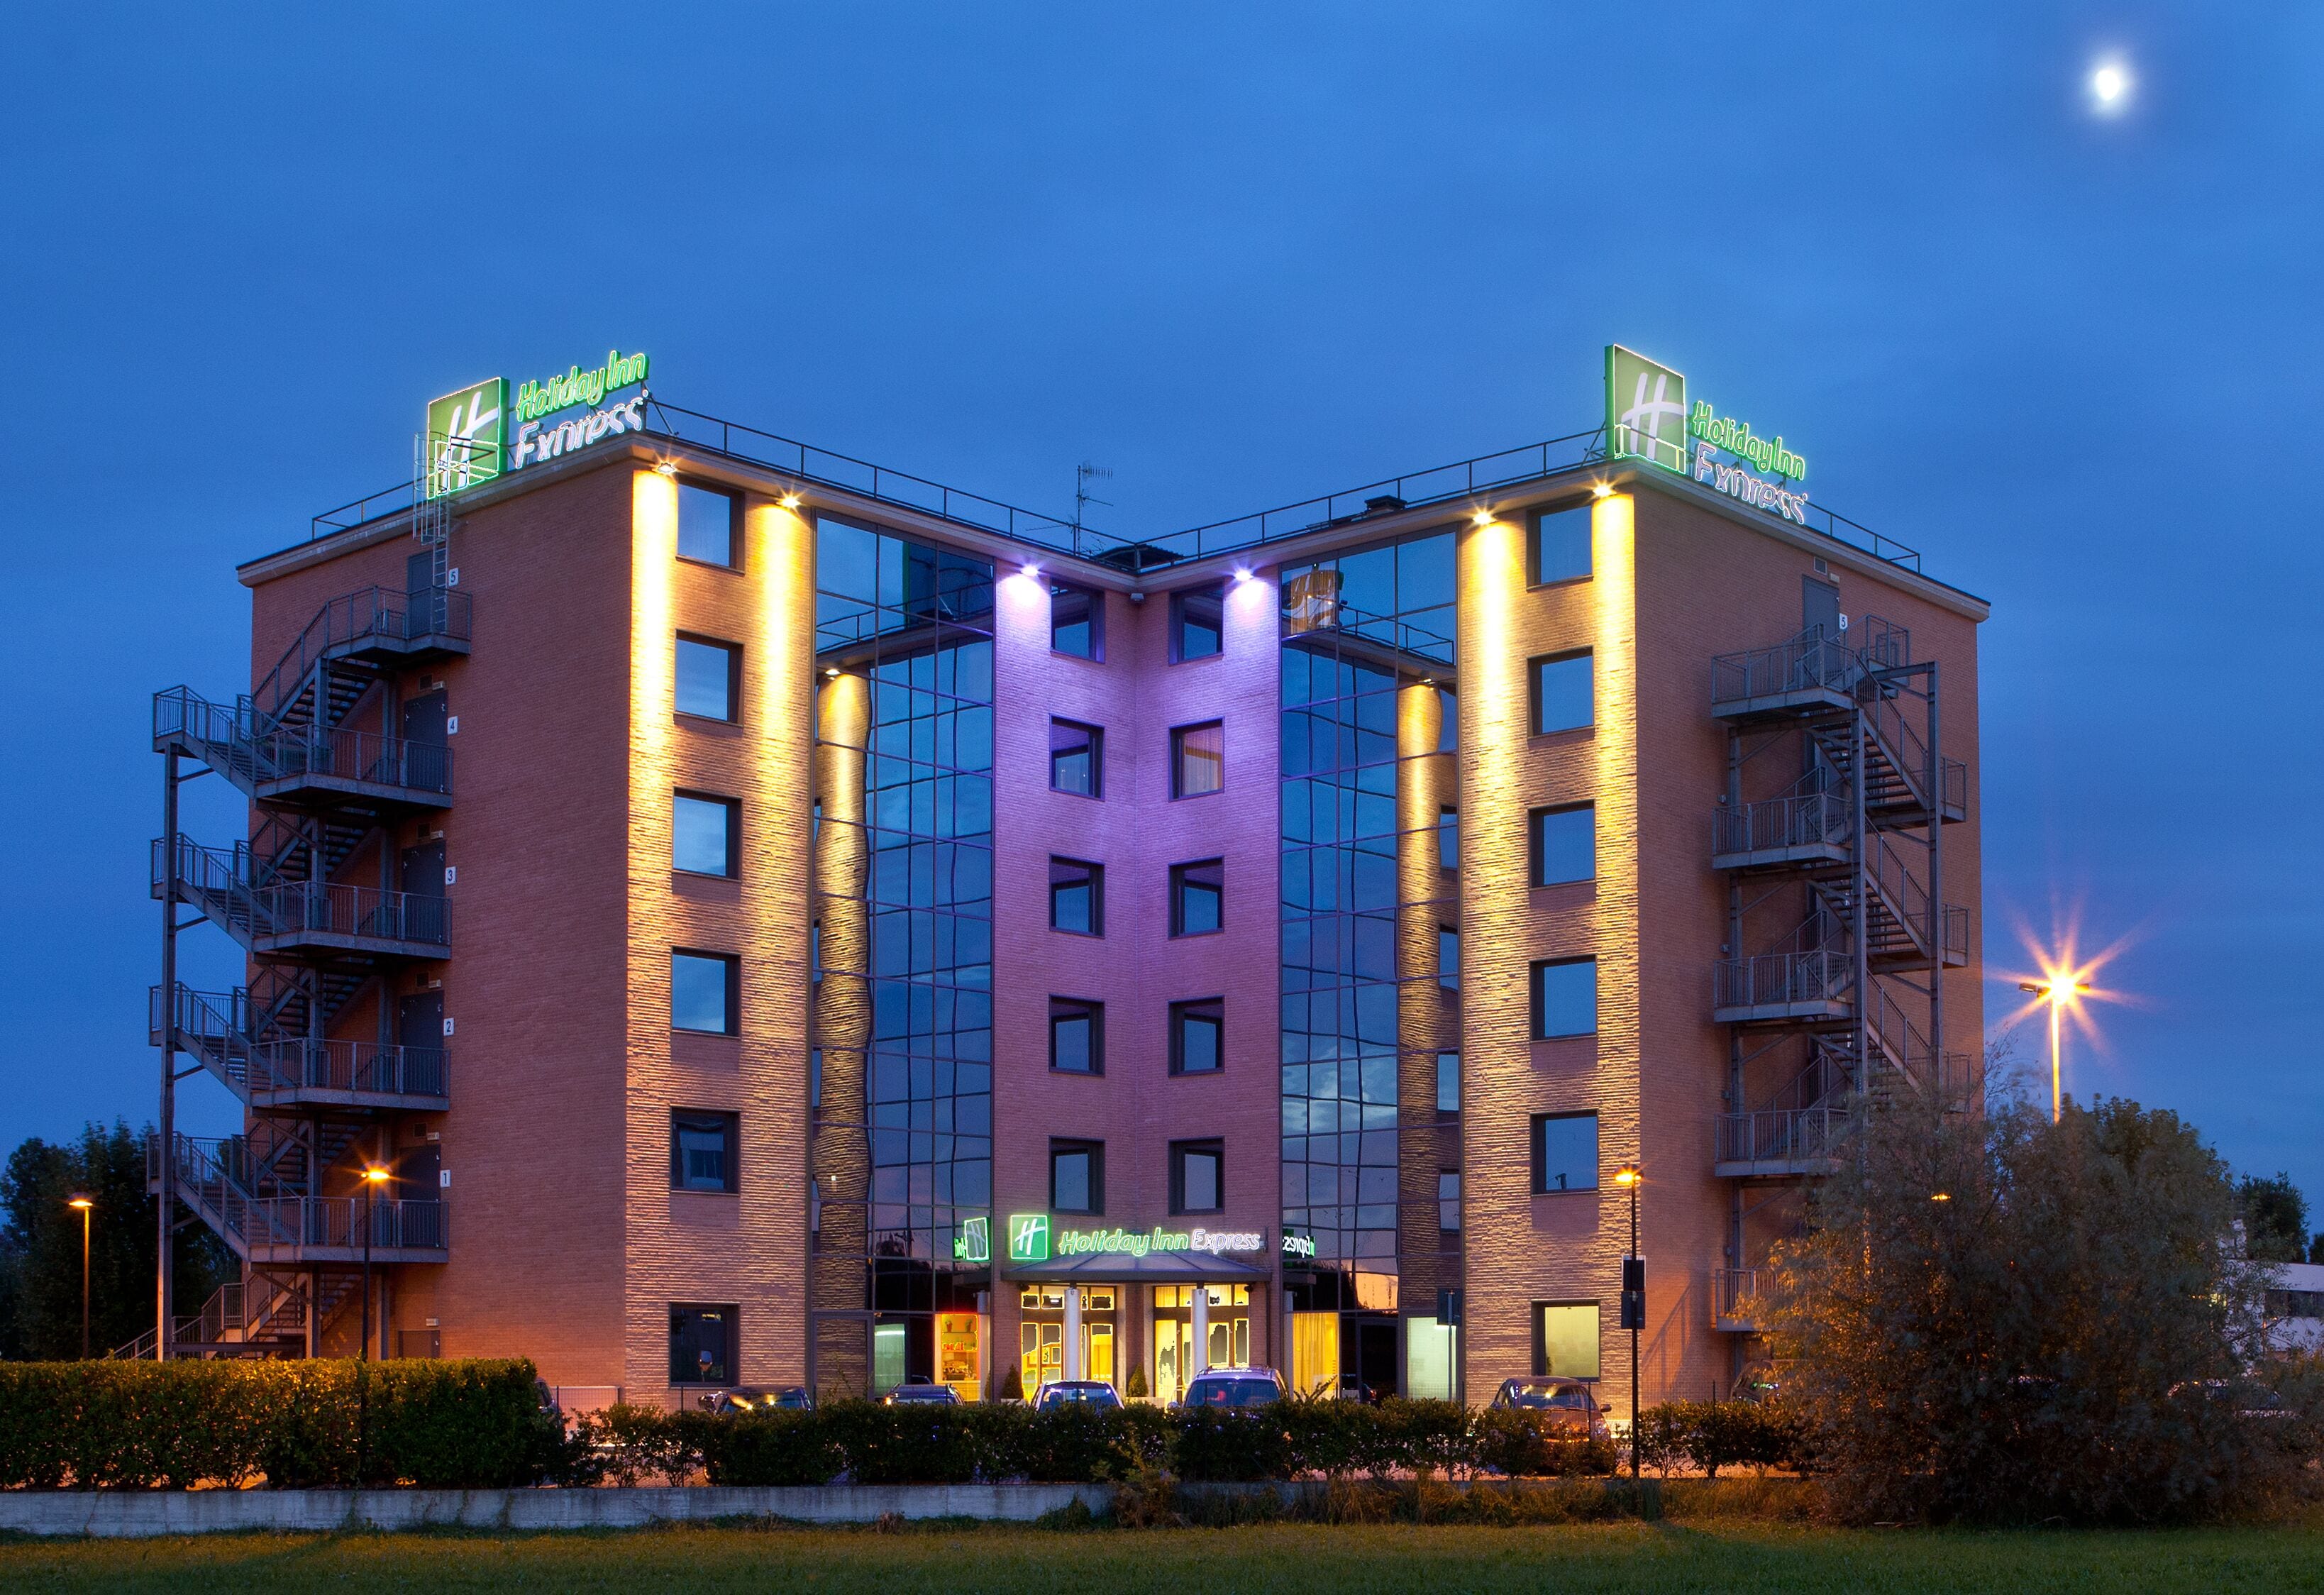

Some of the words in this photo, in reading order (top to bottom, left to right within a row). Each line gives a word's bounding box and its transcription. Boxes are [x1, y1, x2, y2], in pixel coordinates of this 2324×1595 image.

[516, 365, 607, 421] Holiday
[607, 350, 648, 390] Inn
[1693, 400, 1773, 473] Holiday
[1773, 436, 1806, 481] Inn
[1059, 1228, 1150, 1257] Holiday
[1151, 1227, 1189, 1251] Inn
[1190, 1229, 1261, 1255] Express
